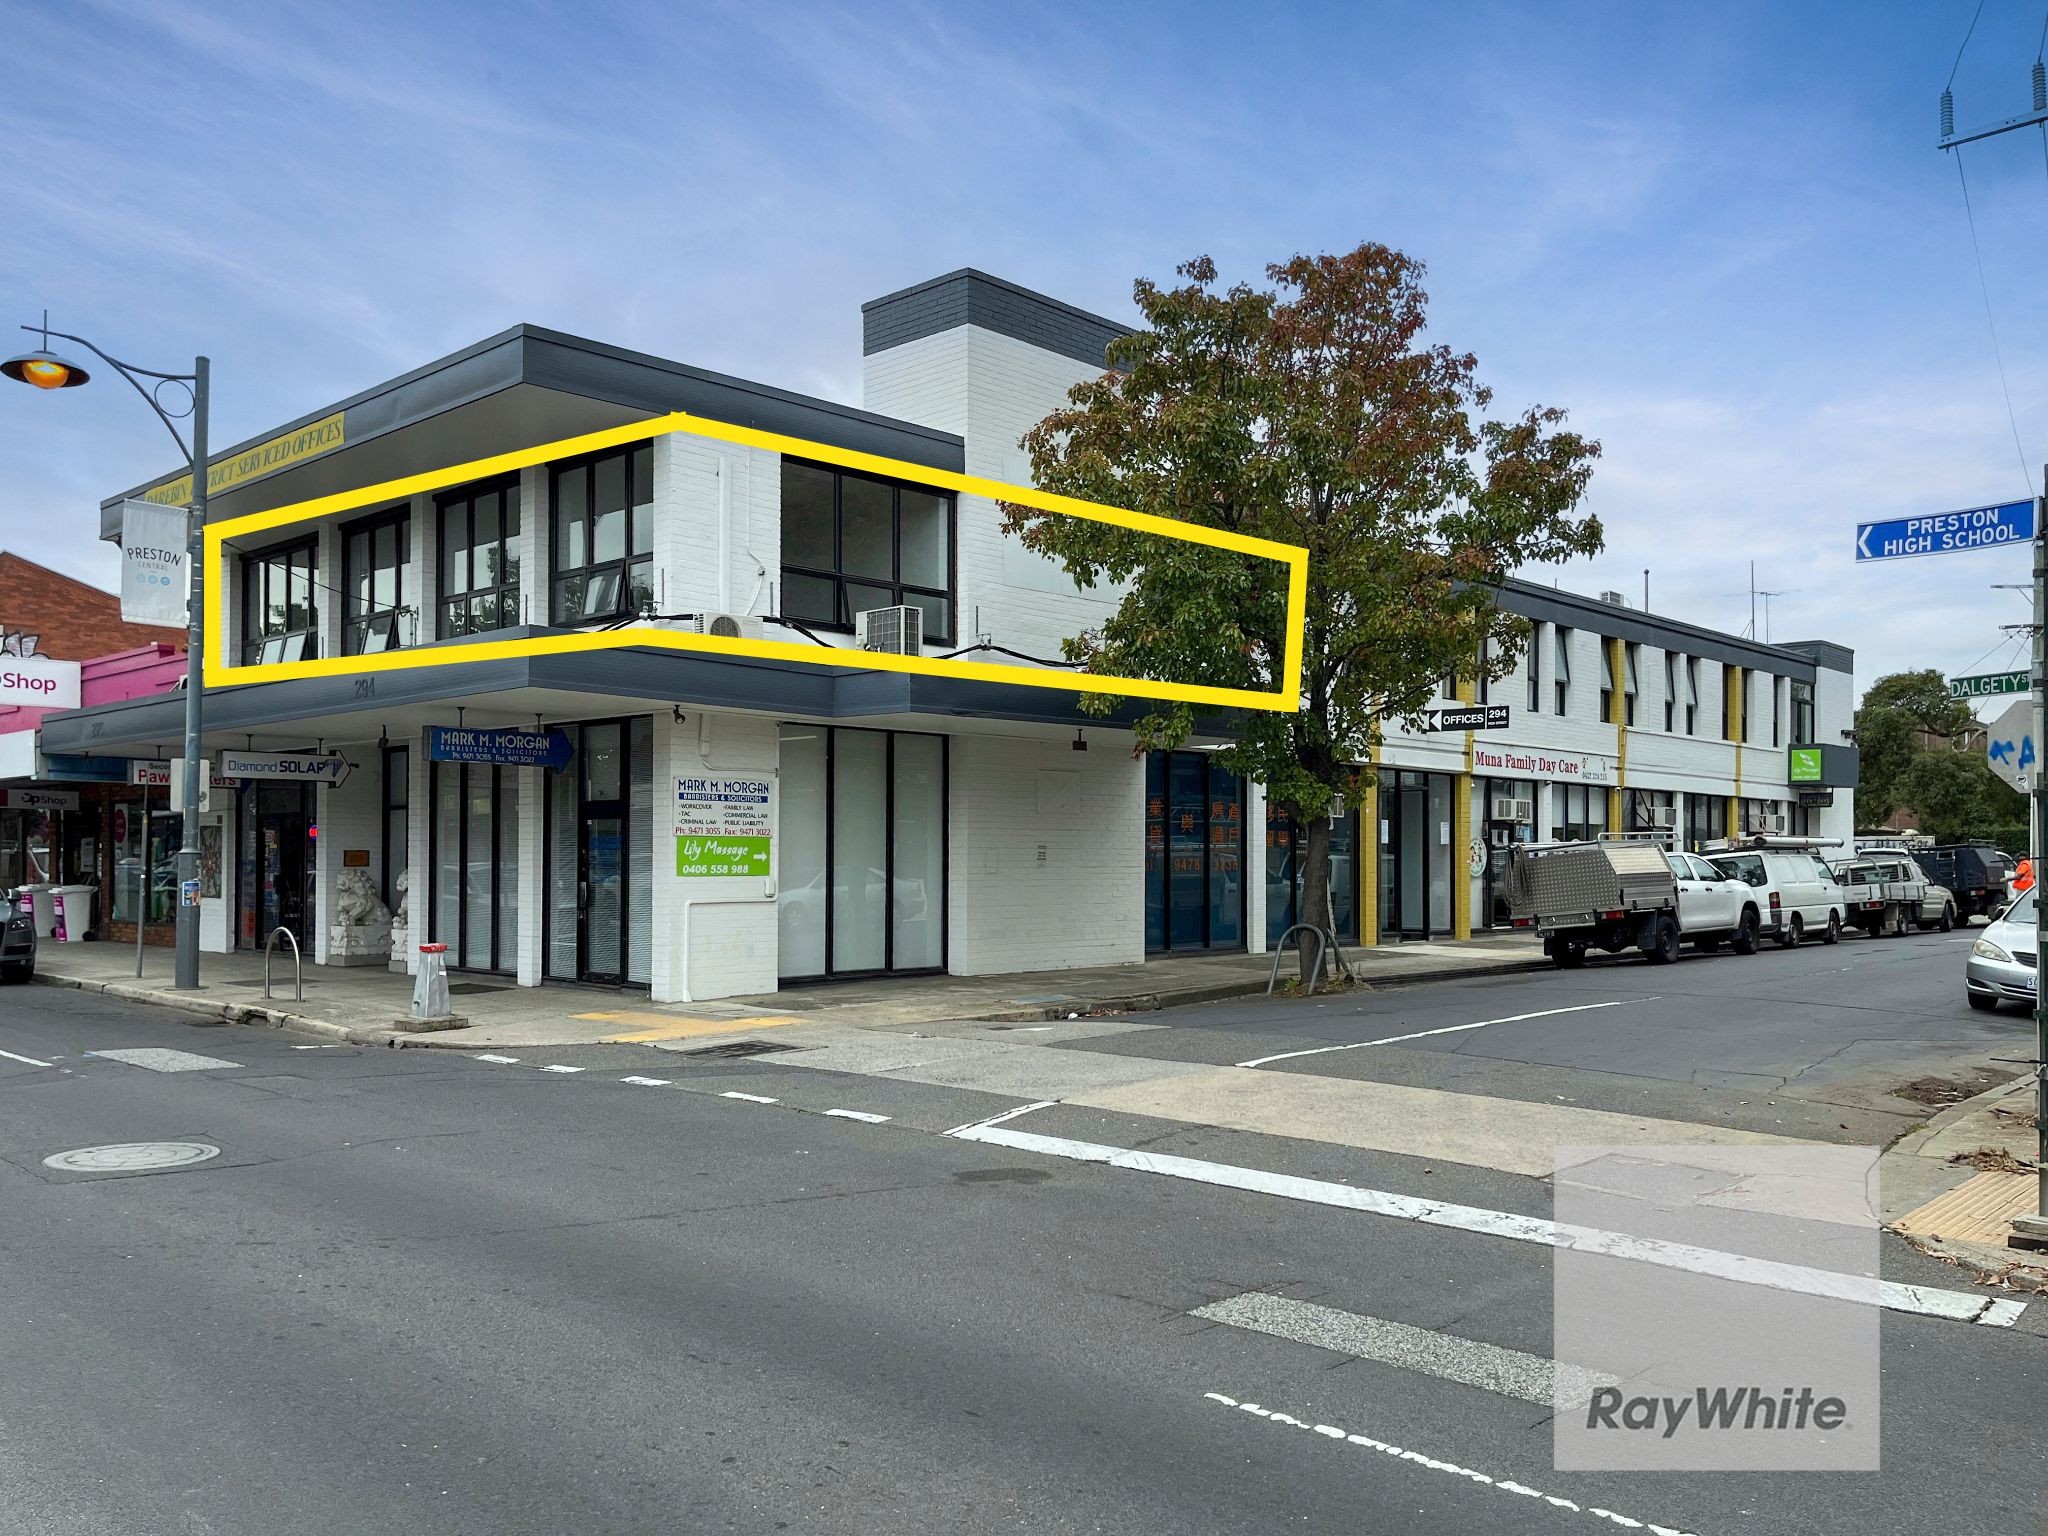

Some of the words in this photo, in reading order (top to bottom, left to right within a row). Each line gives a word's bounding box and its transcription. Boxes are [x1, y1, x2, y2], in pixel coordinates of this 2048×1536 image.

[237, 440, 291, 477] SERVICED
[292, 419, 342, 455] OFFICES
[1906, 507, 1999, 536] PRESTON
[1883, 535, 1932, 556] HIGH
[1942, 523, 2021, 549] SCHOOL
[127, 547, 182, 567] PRESTON
[137, 561, 168, 572] CENTRAL
[354, 676, 375, 698] 294
[1950, 674, 2021, 698] DALGETY
[1443, 713, 1484, 725] OFFICES
[1488, 709, 1507, 719] 294
[440, 744, 488, 753] BARRISTERS
[441, 731, 475, 746] MARK
[479, 734, 492, 747] M.
[495, 735, 550, 749] MORGAN
[228, 760, 277, 772] Diamond
[1475, 751, 1502, 767] Muna
[1505, 753, 1536, 773] Family
[1538, 757, 1557, 775] Day
[1558, 759, 1579, 774] Care
[678, 779, 707, 792] MARK
[710, 781, 721, 793] M.
[724, 781, 769, 795] MORGAN
[683, 793, 718, 801] BARRISTERS
[727, 795, 762, 803] SOLICITORS
[675, 827, 686, 835] Ph:
[688, 827, 704, 835] 9471
[705, 827, 721, 835] 3055
[724, 827, 738, 835] Fax:
[755, 828, 771, 836] 3022
[684, 839, 701, 861] Lily
[704, 840, 749, 861] Massage
[682, 864, 708, 874] 0406
[710, 865, 728, 874] 558
[730, 865, 749, 874] 988
[1174, 858, 1200, 871] 9478
